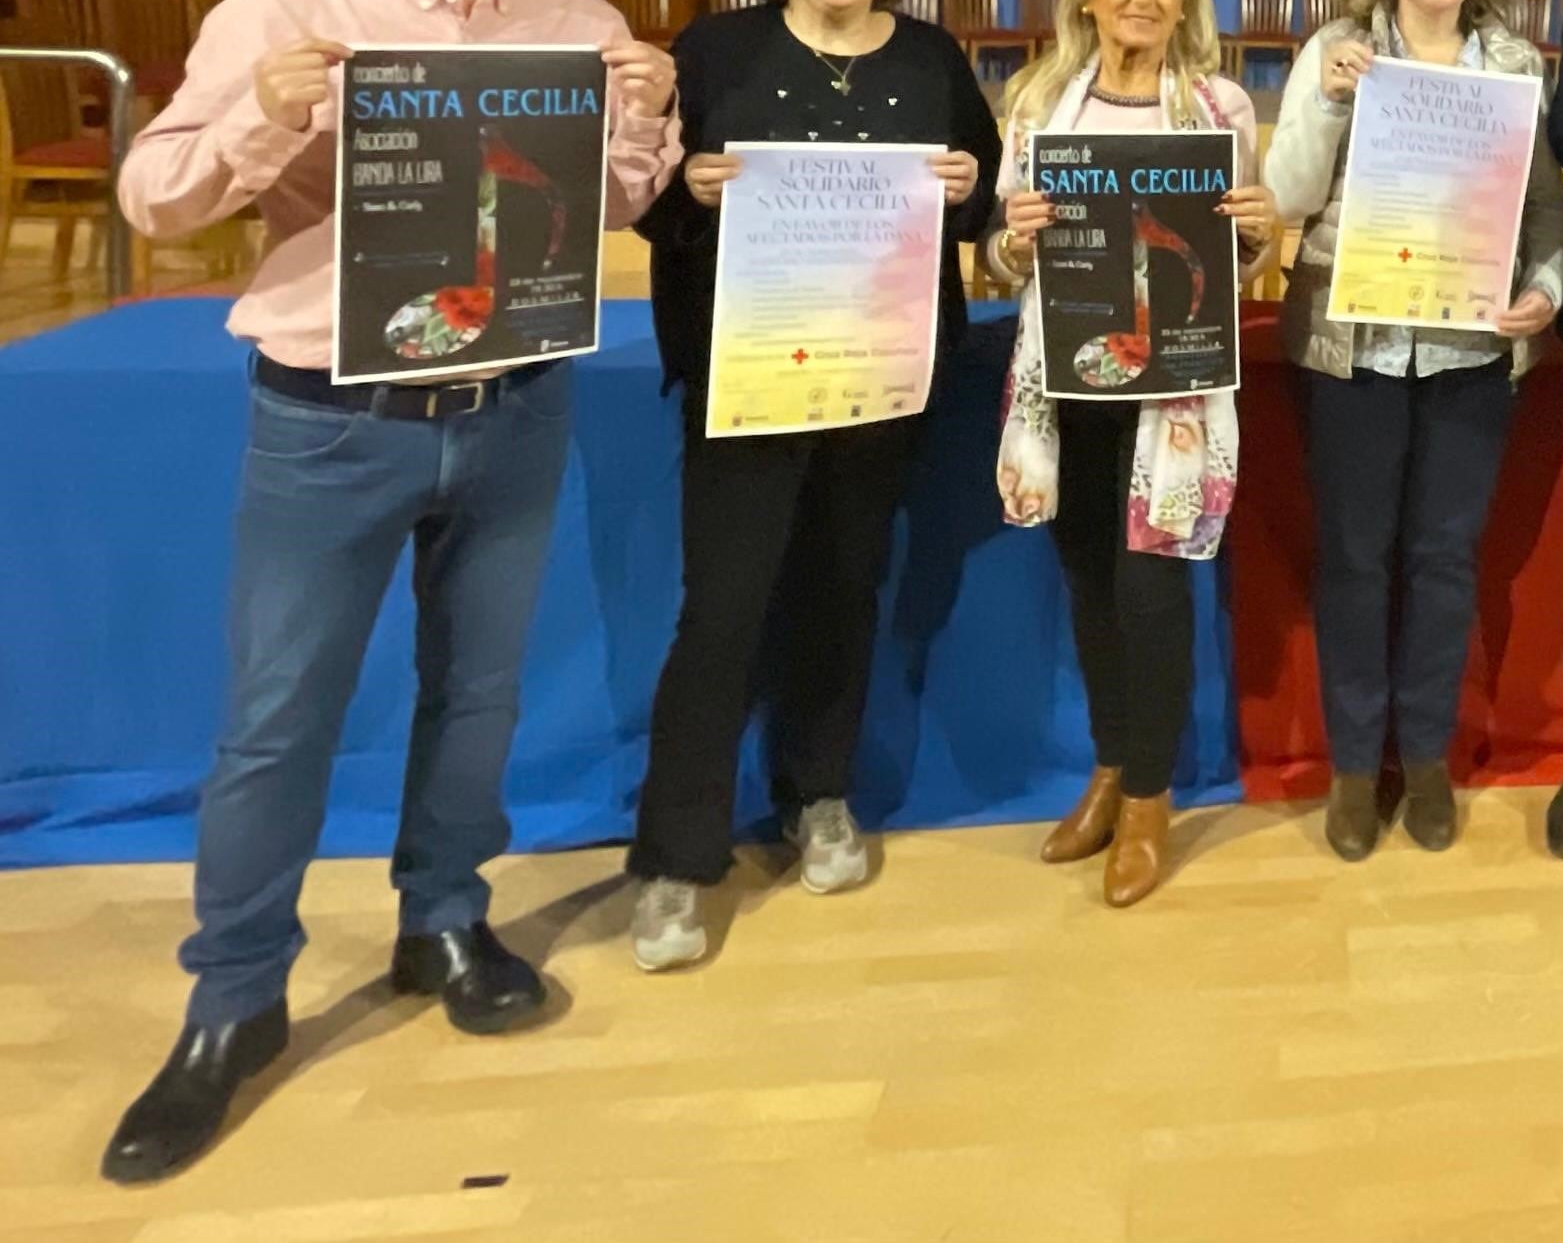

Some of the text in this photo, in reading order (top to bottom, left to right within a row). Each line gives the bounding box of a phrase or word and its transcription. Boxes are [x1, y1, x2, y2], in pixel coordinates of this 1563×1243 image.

[1409, 76, 1482, 96] FESTIVAL
[354, 87, 599, 119] SANTA CECILIA
[1401, 91, 1493, 115] SOLIDARIO
[1380, 105, 1507, 134] SANTA CECILIA
[1039, 144, 1092, 164] concierto de
[353, 160, 443, 186] BANDA LA LIRA
[788, 159, 877, 174] FESTIVAL
[780, 177, 892, 192] SOLIDARIO
[1040, 169, 1226, 194] SANTA CECILIA
[758, 194, 910, 210] SANTA CECILIA
[1074, 229, 1086, 248] LA
